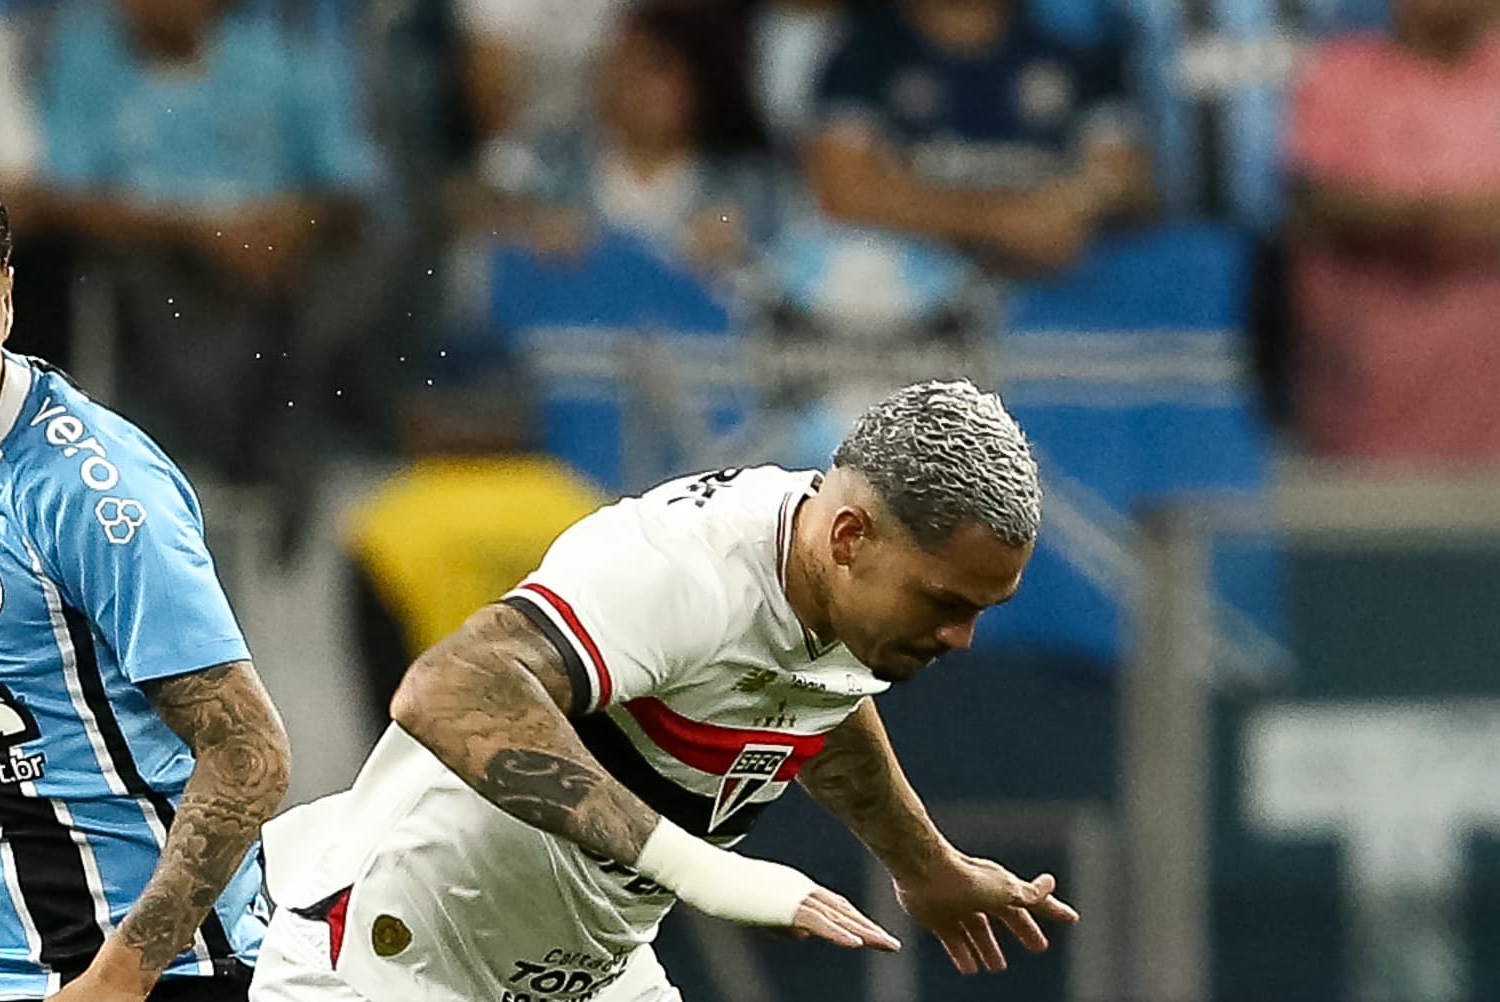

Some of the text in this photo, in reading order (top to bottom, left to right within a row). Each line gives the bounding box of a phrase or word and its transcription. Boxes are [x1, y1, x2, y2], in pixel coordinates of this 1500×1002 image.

[28, 397, 120, 491] vero
[735, 754, 782, 771] SPFC
[508, 960, 626, 994] TOD
